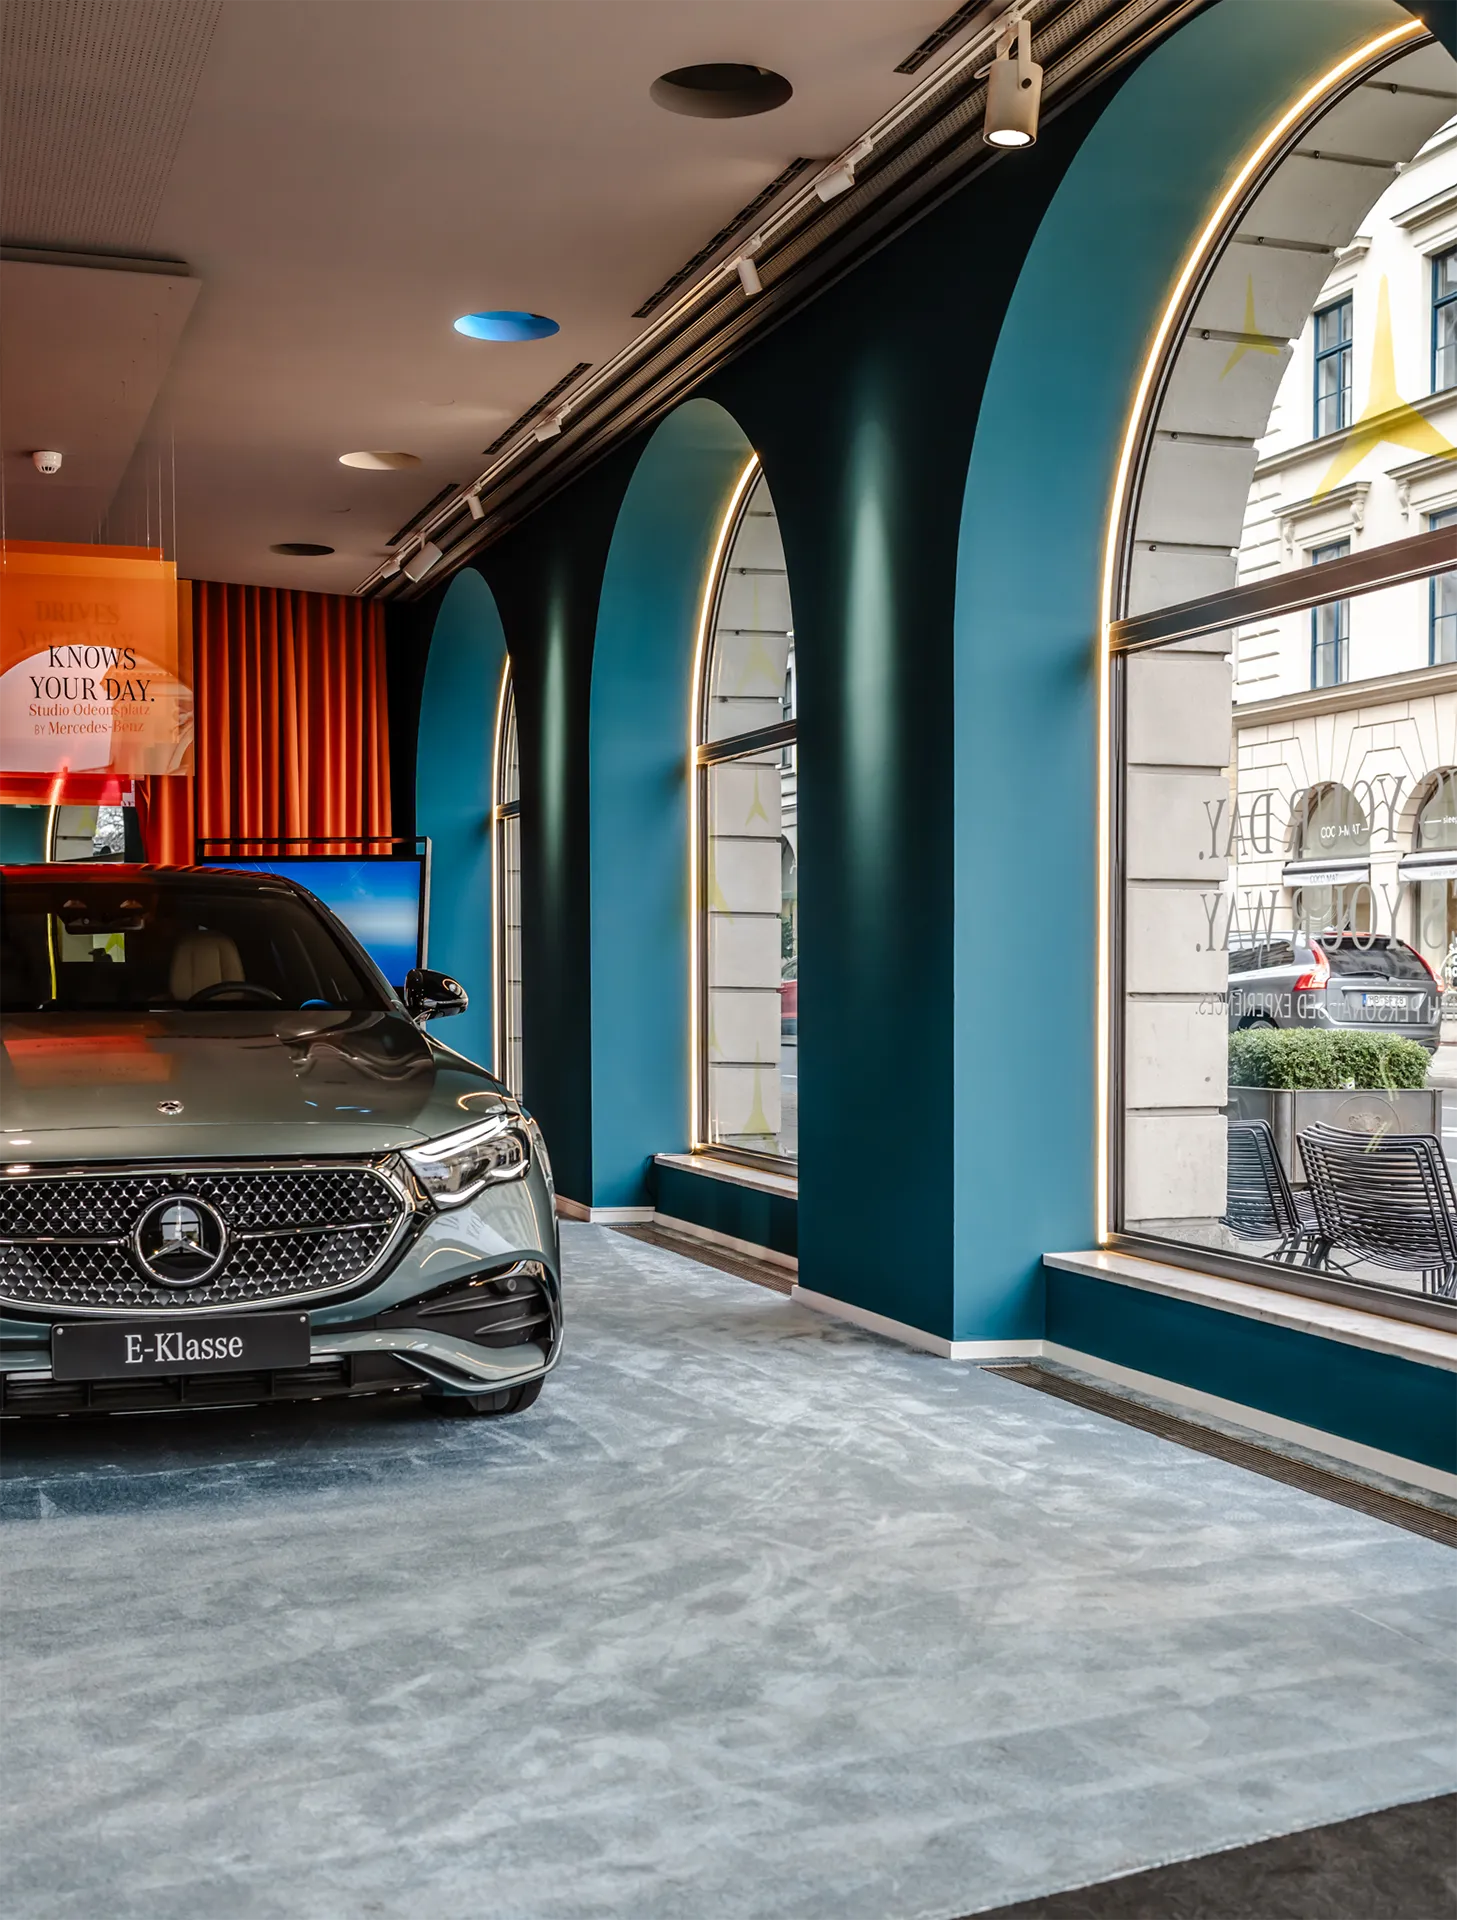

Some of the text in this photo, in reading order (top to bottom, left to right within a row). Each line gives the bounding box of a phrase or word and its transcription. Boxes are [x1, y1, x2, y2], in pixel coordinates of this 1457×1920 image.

[34, 600, 120, 625] DRIVES
[48, 644, 136, 670] KNOWS
[29, 676, 155, 702] YOUR DAY.
[29, 703, 151, 719] Studio Odeonsplatz
[34, 721, 144, 735] BY Mercedes-Benz
[125, 1332, 243, 1364] E-Klasse
